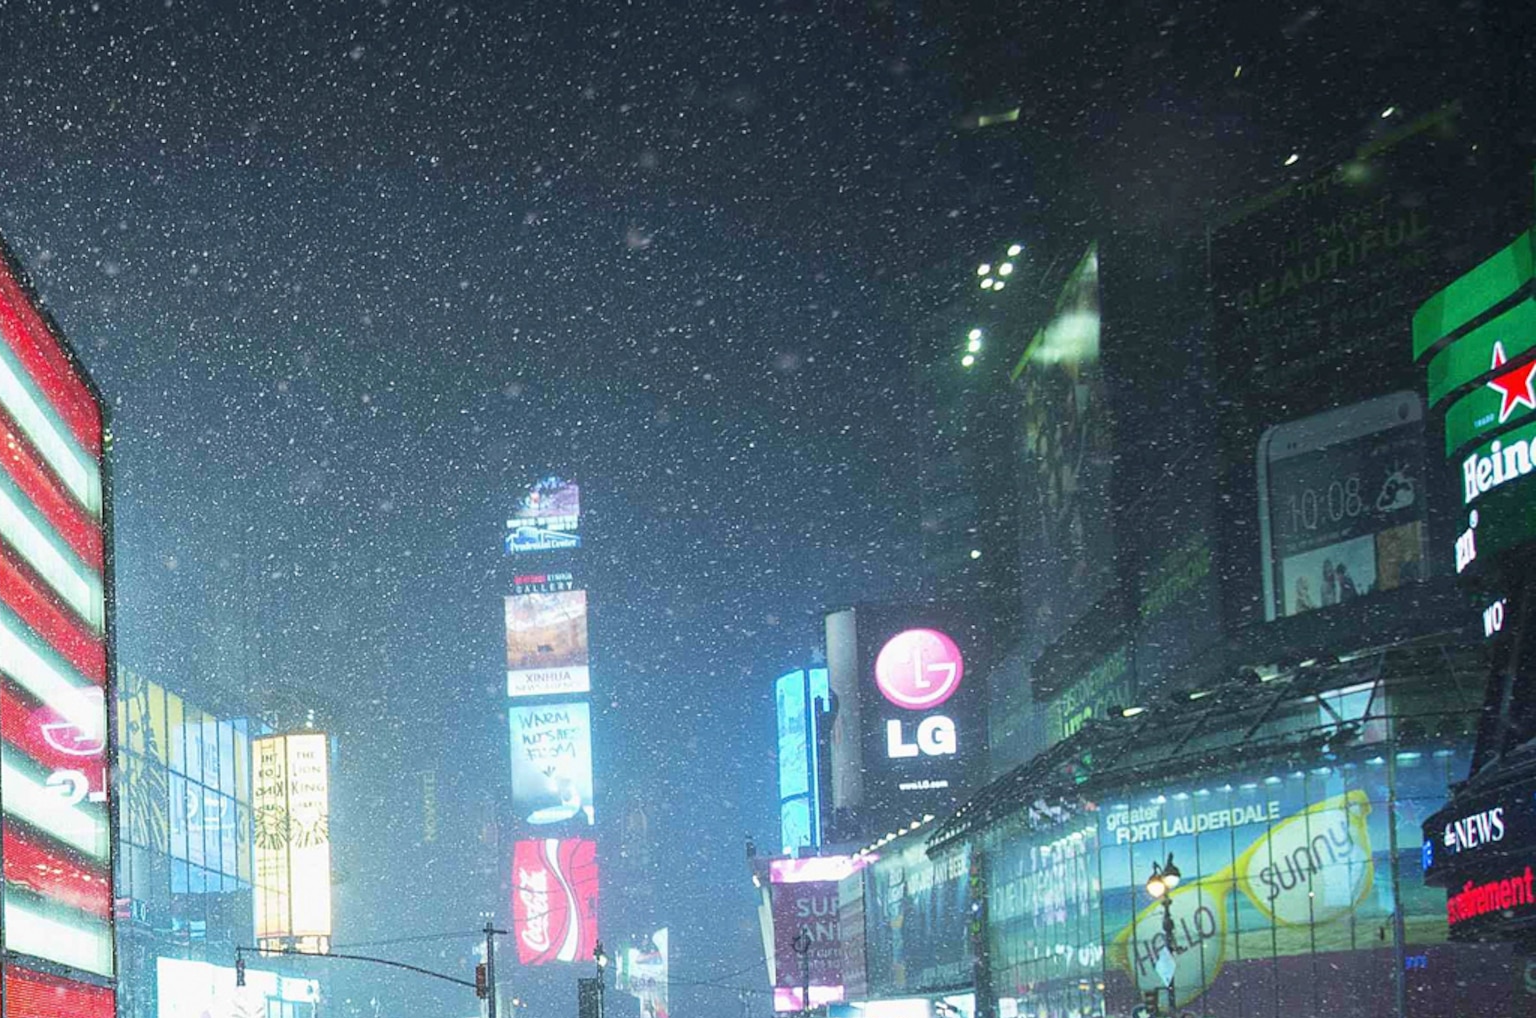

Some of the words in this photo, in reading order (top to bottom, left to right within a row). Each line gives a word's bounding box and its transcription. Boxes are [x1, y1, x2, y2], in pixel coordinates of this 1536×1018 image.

[525, 670, 572, 683] XINHUA
[886, 714, 958, 759] LG
[291, 780, 326, 797] KING
[1106, 806, 1161, 831] greater
[1116, 822, 1160, 845] FORT
[1162, 800, 1280, 838] LAUDERDALE
[1454, 807, 1505, 853] NEWS
